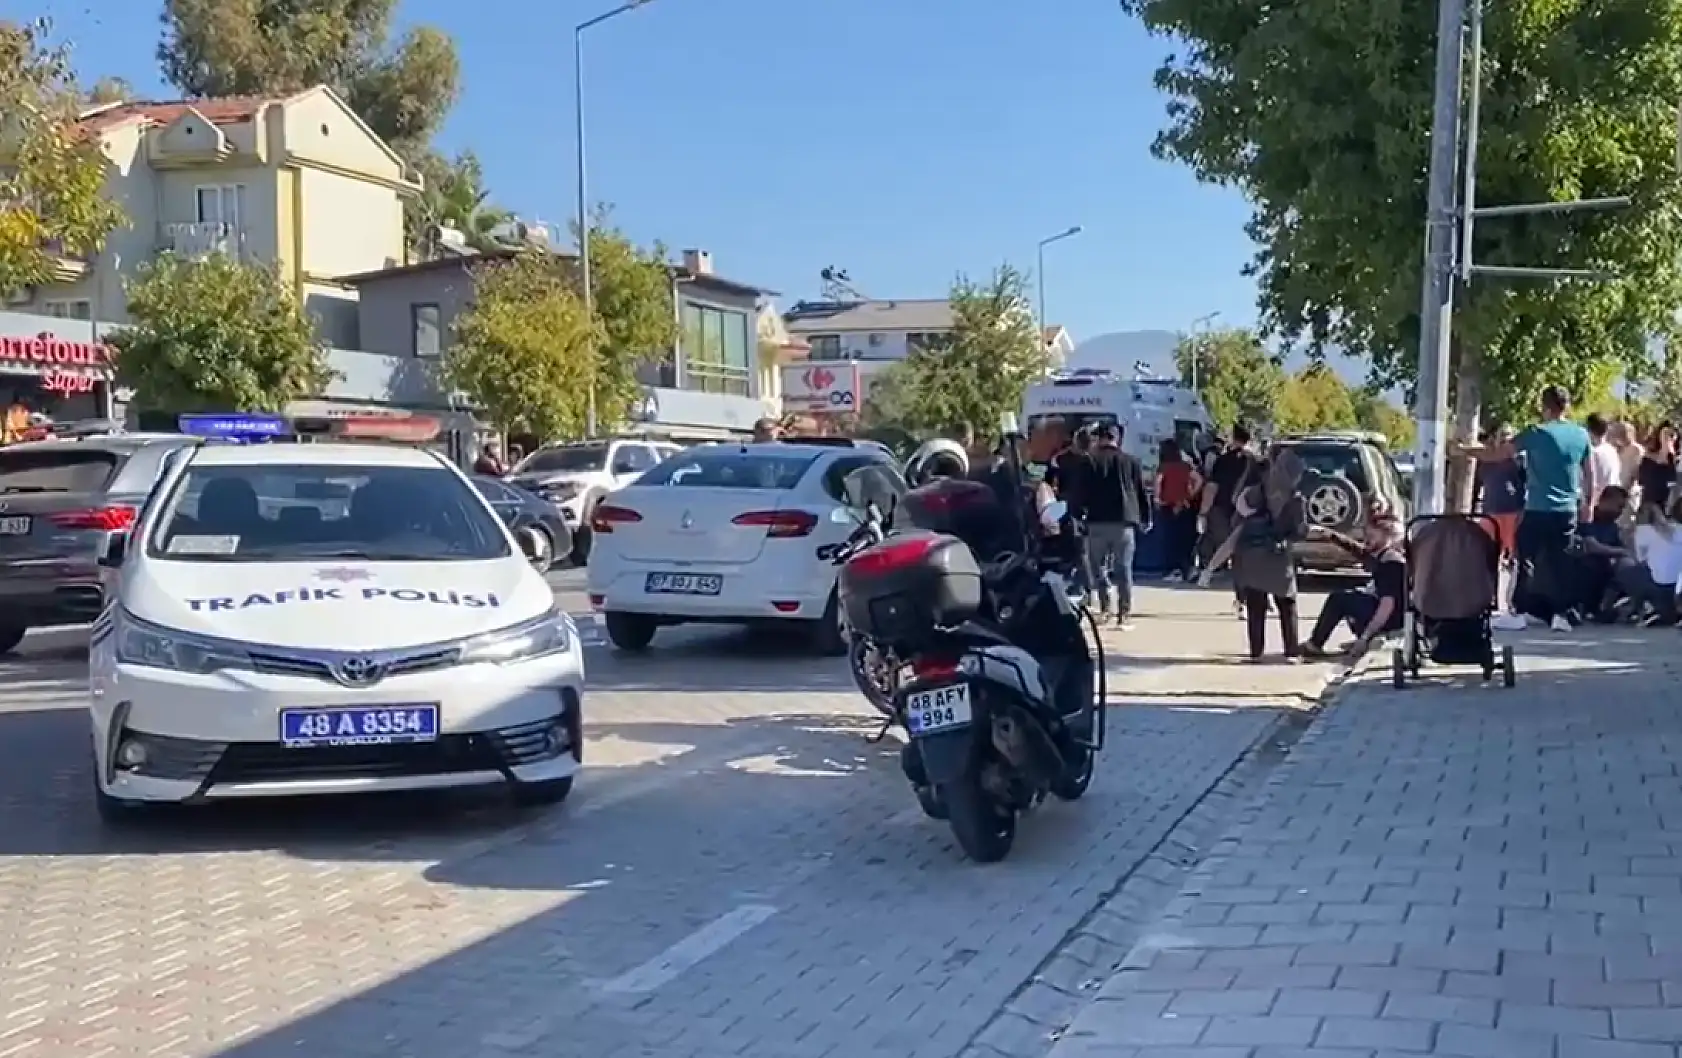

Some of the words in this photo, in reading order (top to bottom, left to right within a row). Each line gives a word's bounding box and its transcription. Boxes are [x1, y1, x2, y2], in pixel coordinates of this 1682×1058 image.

[185, 586, 343, 611] TRAFİK
[911, 695, 930, 709] 48
[936, 686, 966, 706] AFY
[299, 713, 330, 736] 48
[337, 712, 356, 735] A
[362, 709, 422, 734] 8354
[922, 707, 955, 727] 994
